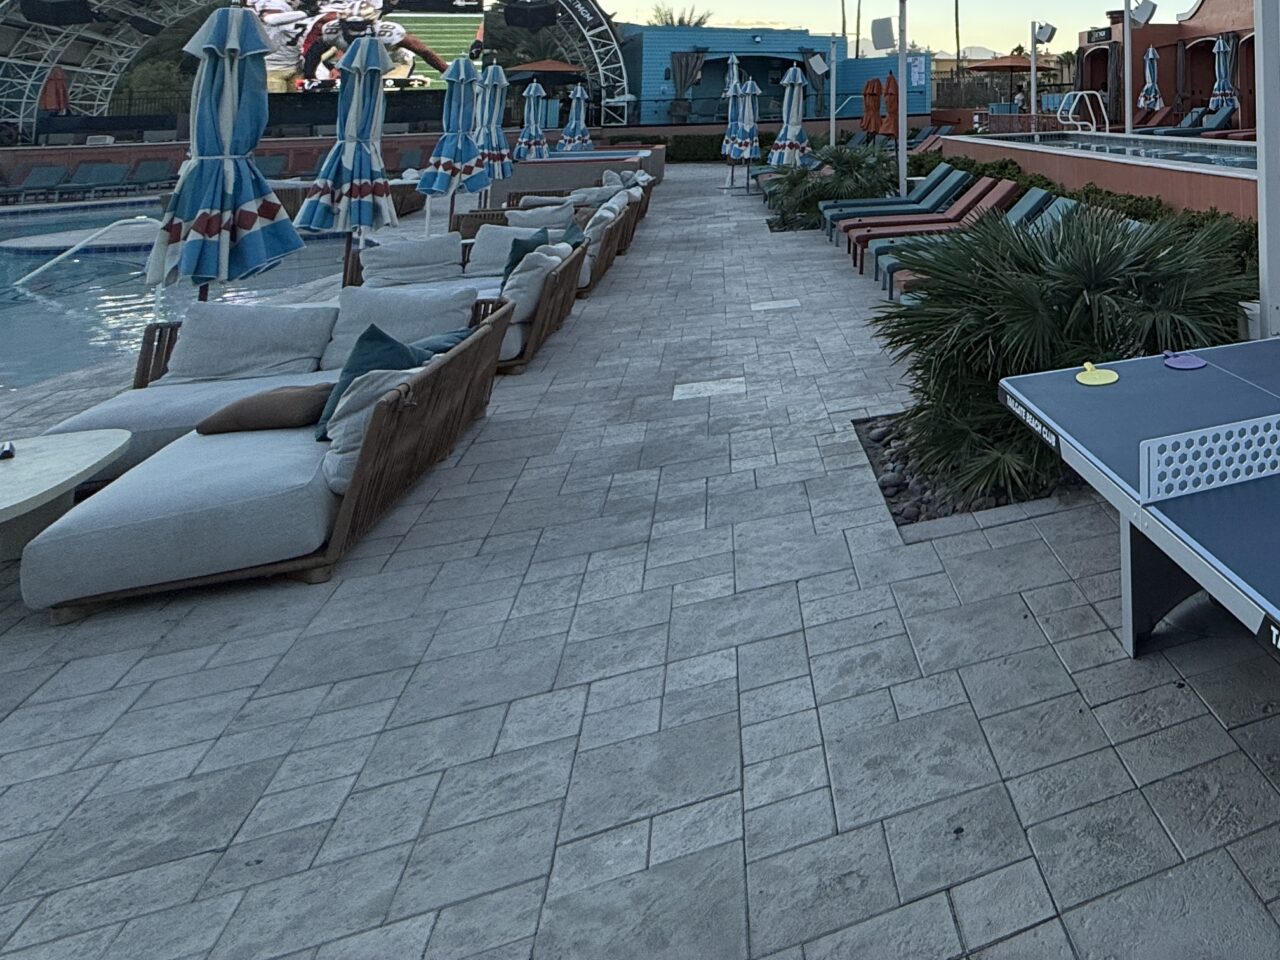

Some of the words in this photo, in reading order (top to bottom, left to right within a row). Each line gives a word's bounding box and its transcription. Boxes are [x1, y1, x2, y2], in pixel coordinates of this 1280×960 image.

[1006, 394, 1026, 420] TAILGATE
[1026, 411, 1042, 434] BEACH
[1042, 426, 1056, 447] CLUB
